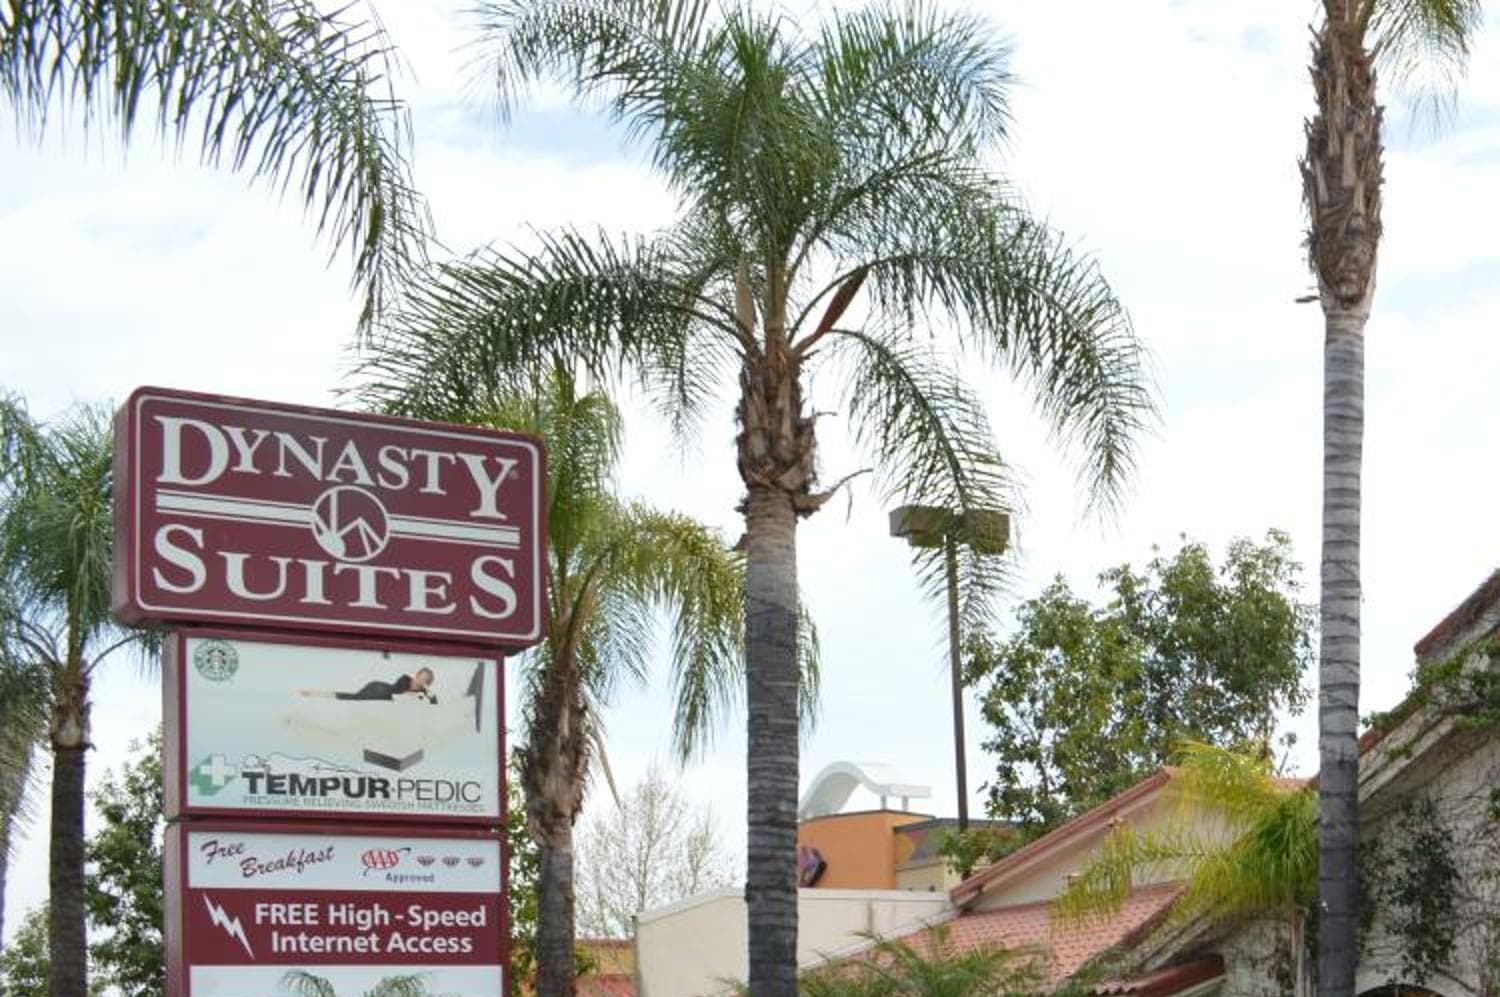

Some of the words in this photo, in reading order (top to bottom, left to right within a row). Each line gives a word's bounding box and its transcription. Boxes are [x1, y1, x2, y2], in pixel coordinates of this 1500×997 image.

[153, 415, 518, 520] DYNASTY
[152, 524, 517, 619] SUITES
[201, 840, 245, 864] Free
[240, 845, 334, 878] Breakfast
[361, 849, 400, 870] AAA
[386, 872, 435, 884] Approved
[255, 903, 319, 925] FREE
[271, 931, 380, 953] Internet
[387, 932, 473, 953] Access
